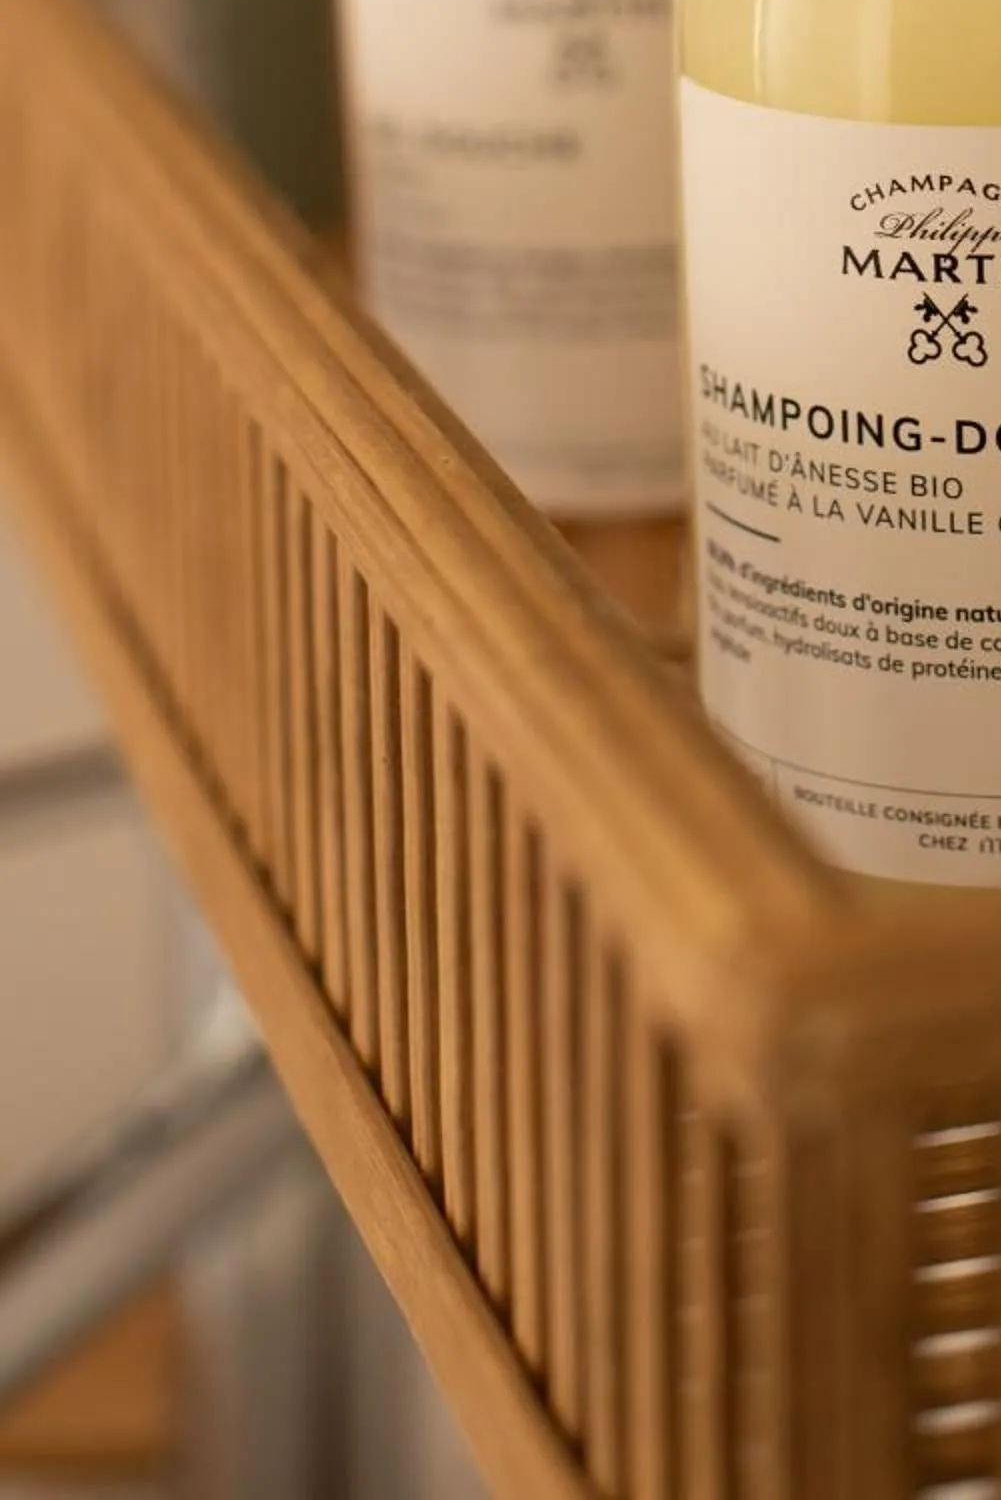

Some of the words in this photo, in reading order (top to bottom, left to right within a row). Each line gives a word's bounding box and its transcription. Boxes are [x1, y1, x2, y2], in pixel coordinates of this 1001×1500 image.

[723, 431, 761, 466] LAIT
[768, 450, 897, 495] D'ÂNESSE
[910, 474, 964, 500] BIO
[787, 484, 803, 515] À
[812, 495, 845, 522] LA
[856, 502, 985, 535] VANILLE
[852, 590, 949, 623] d'origine
[813, 613, 860, 640] doux
[866, 620, 880, 642] à
[885, 624, 939, 649] base
[945, 631, 973, 652] de
[878, 653, 905, 674] de
[882, 804, 992, 830] CONSIGNÉE
[918, 833, 968, 852] CHEZ
